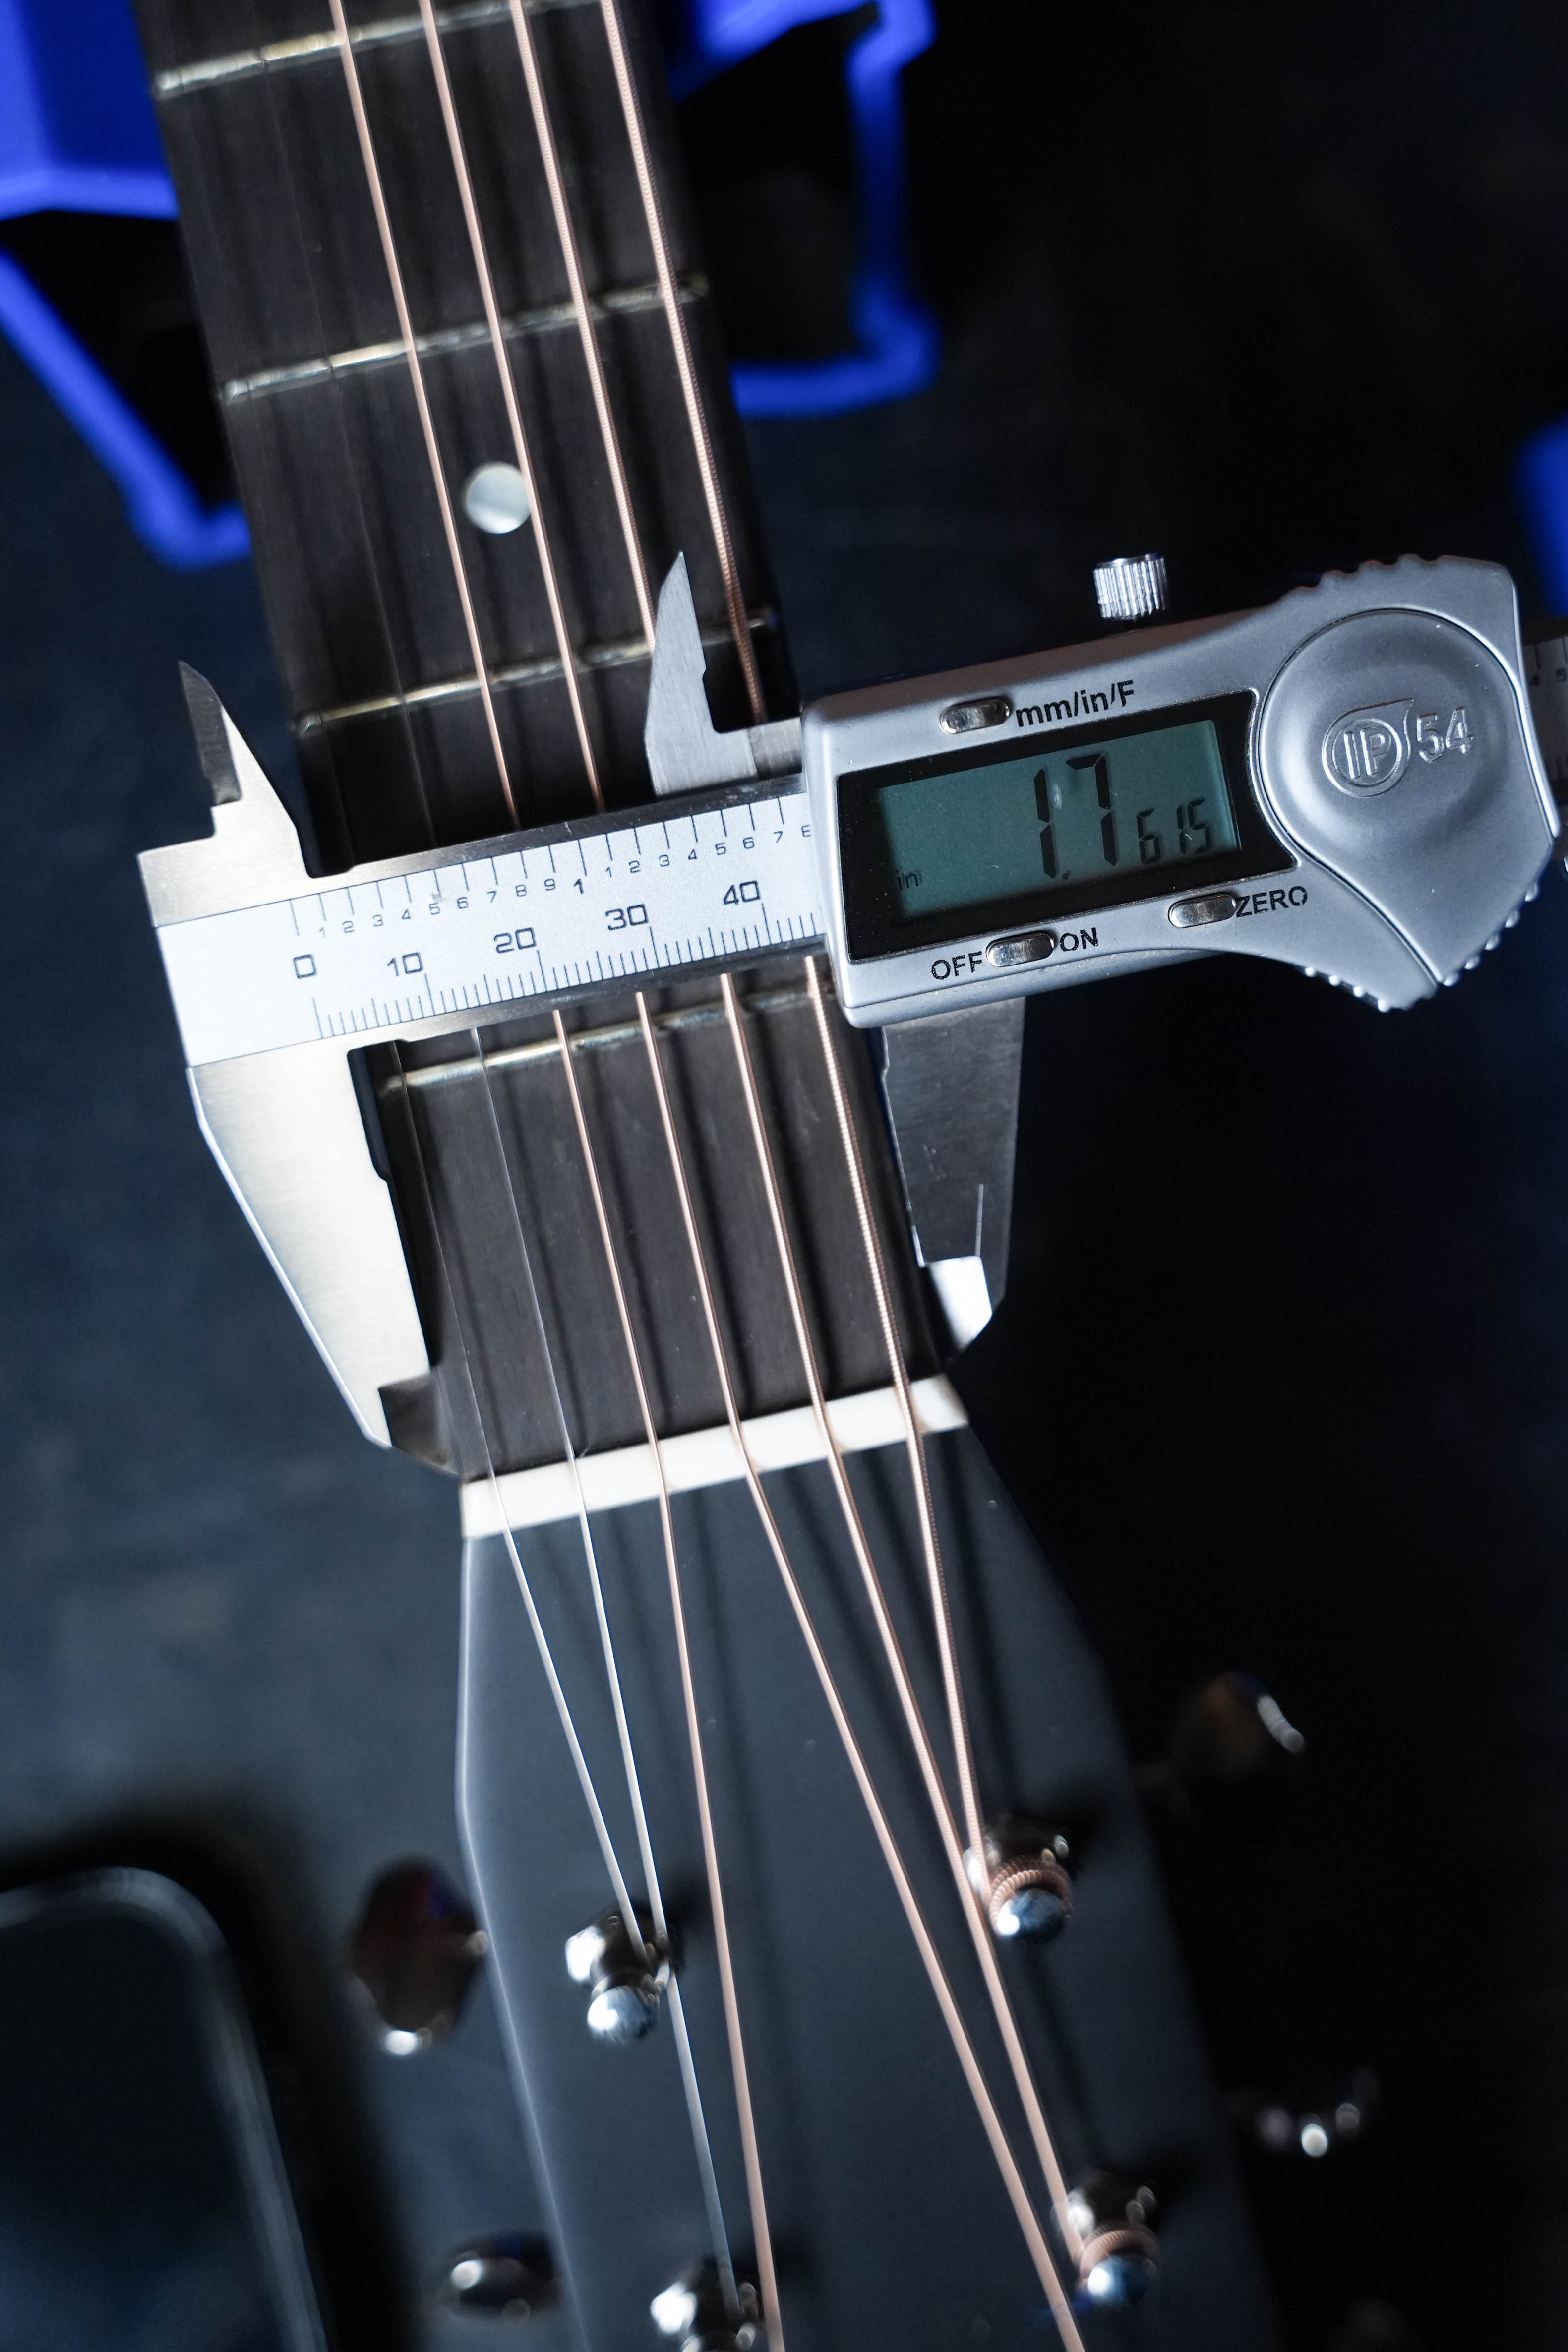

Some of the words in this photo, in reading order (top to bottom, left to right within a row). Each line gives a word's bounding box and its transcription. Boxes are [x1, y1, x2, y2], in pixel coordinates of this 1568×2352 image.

[1016, 679, 1136, 727] mm/in/F
[1343, 725, 1391, 779] IP
[1416, 706, 1474, 763] 54
[319, 927, 326, 938] 1
[342, 920, 355, 933] 2
[372, 914, 384, 927] 3
[401, 908, 412, 920] 4
[428, 903, 441, 915] 5
[456, 897, 469, 909] 6
[486, 890, 497, 903] 7
[515, 884, 527, 897] 8
[544, 878, 556, 891] 9
[573, 878, 584, 894] 1
[605, 866, 612, 878] 1
[629, 860, 641, 873] 2
[659, 854, 670, 867] 3
[687, 848, 698, 861] 4
[715, 842, 727, 855] 5
[742, 837, 755, 849] 6
[773, 831, 783, 844] 7
[895, 869, 920, 891] in
[1235, 885, 1308, 918] ZERO
[293, 954, 317, 979] 0
[386, 952, 424, 977] 10
[493, 927, 536, 954] 20
[605, 904, 649, 931] 30
[723, 880, 761, 905] 40
[1059, 927, 1099, 953] ON
[931, 952, 983, 981] OFF
